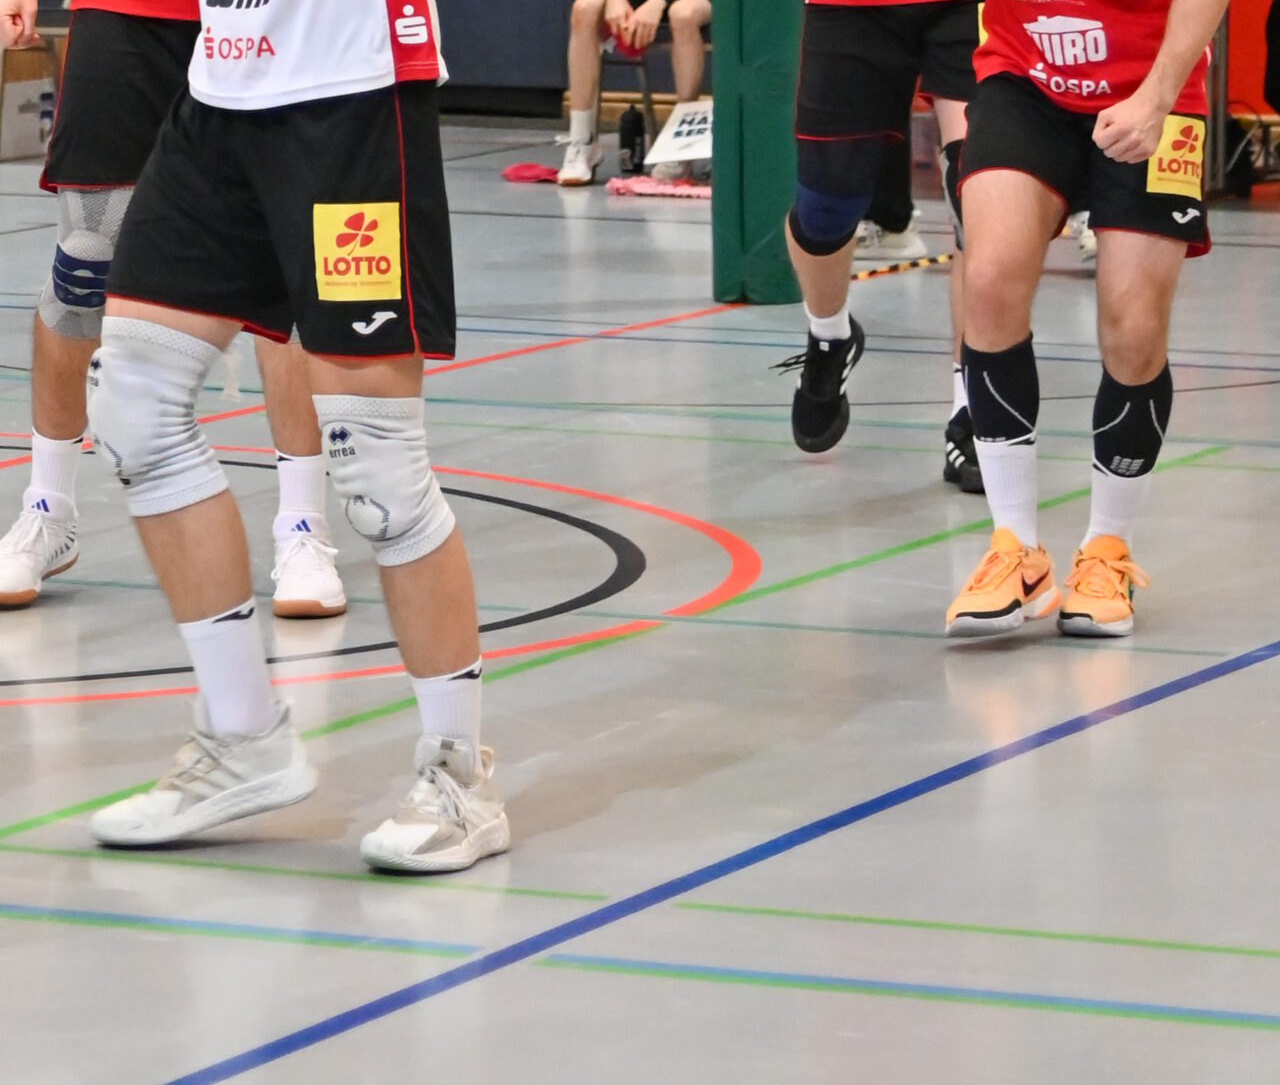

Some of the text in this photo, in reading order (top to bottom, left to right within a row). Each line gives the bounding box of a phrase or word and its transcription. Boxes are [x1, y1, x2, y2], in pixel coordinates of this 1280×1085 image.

[218, 34, 277, 61] OSPA
[1049, 75, 1112, 97] OSPA
[323, 255, 391, 276] LOTTO
